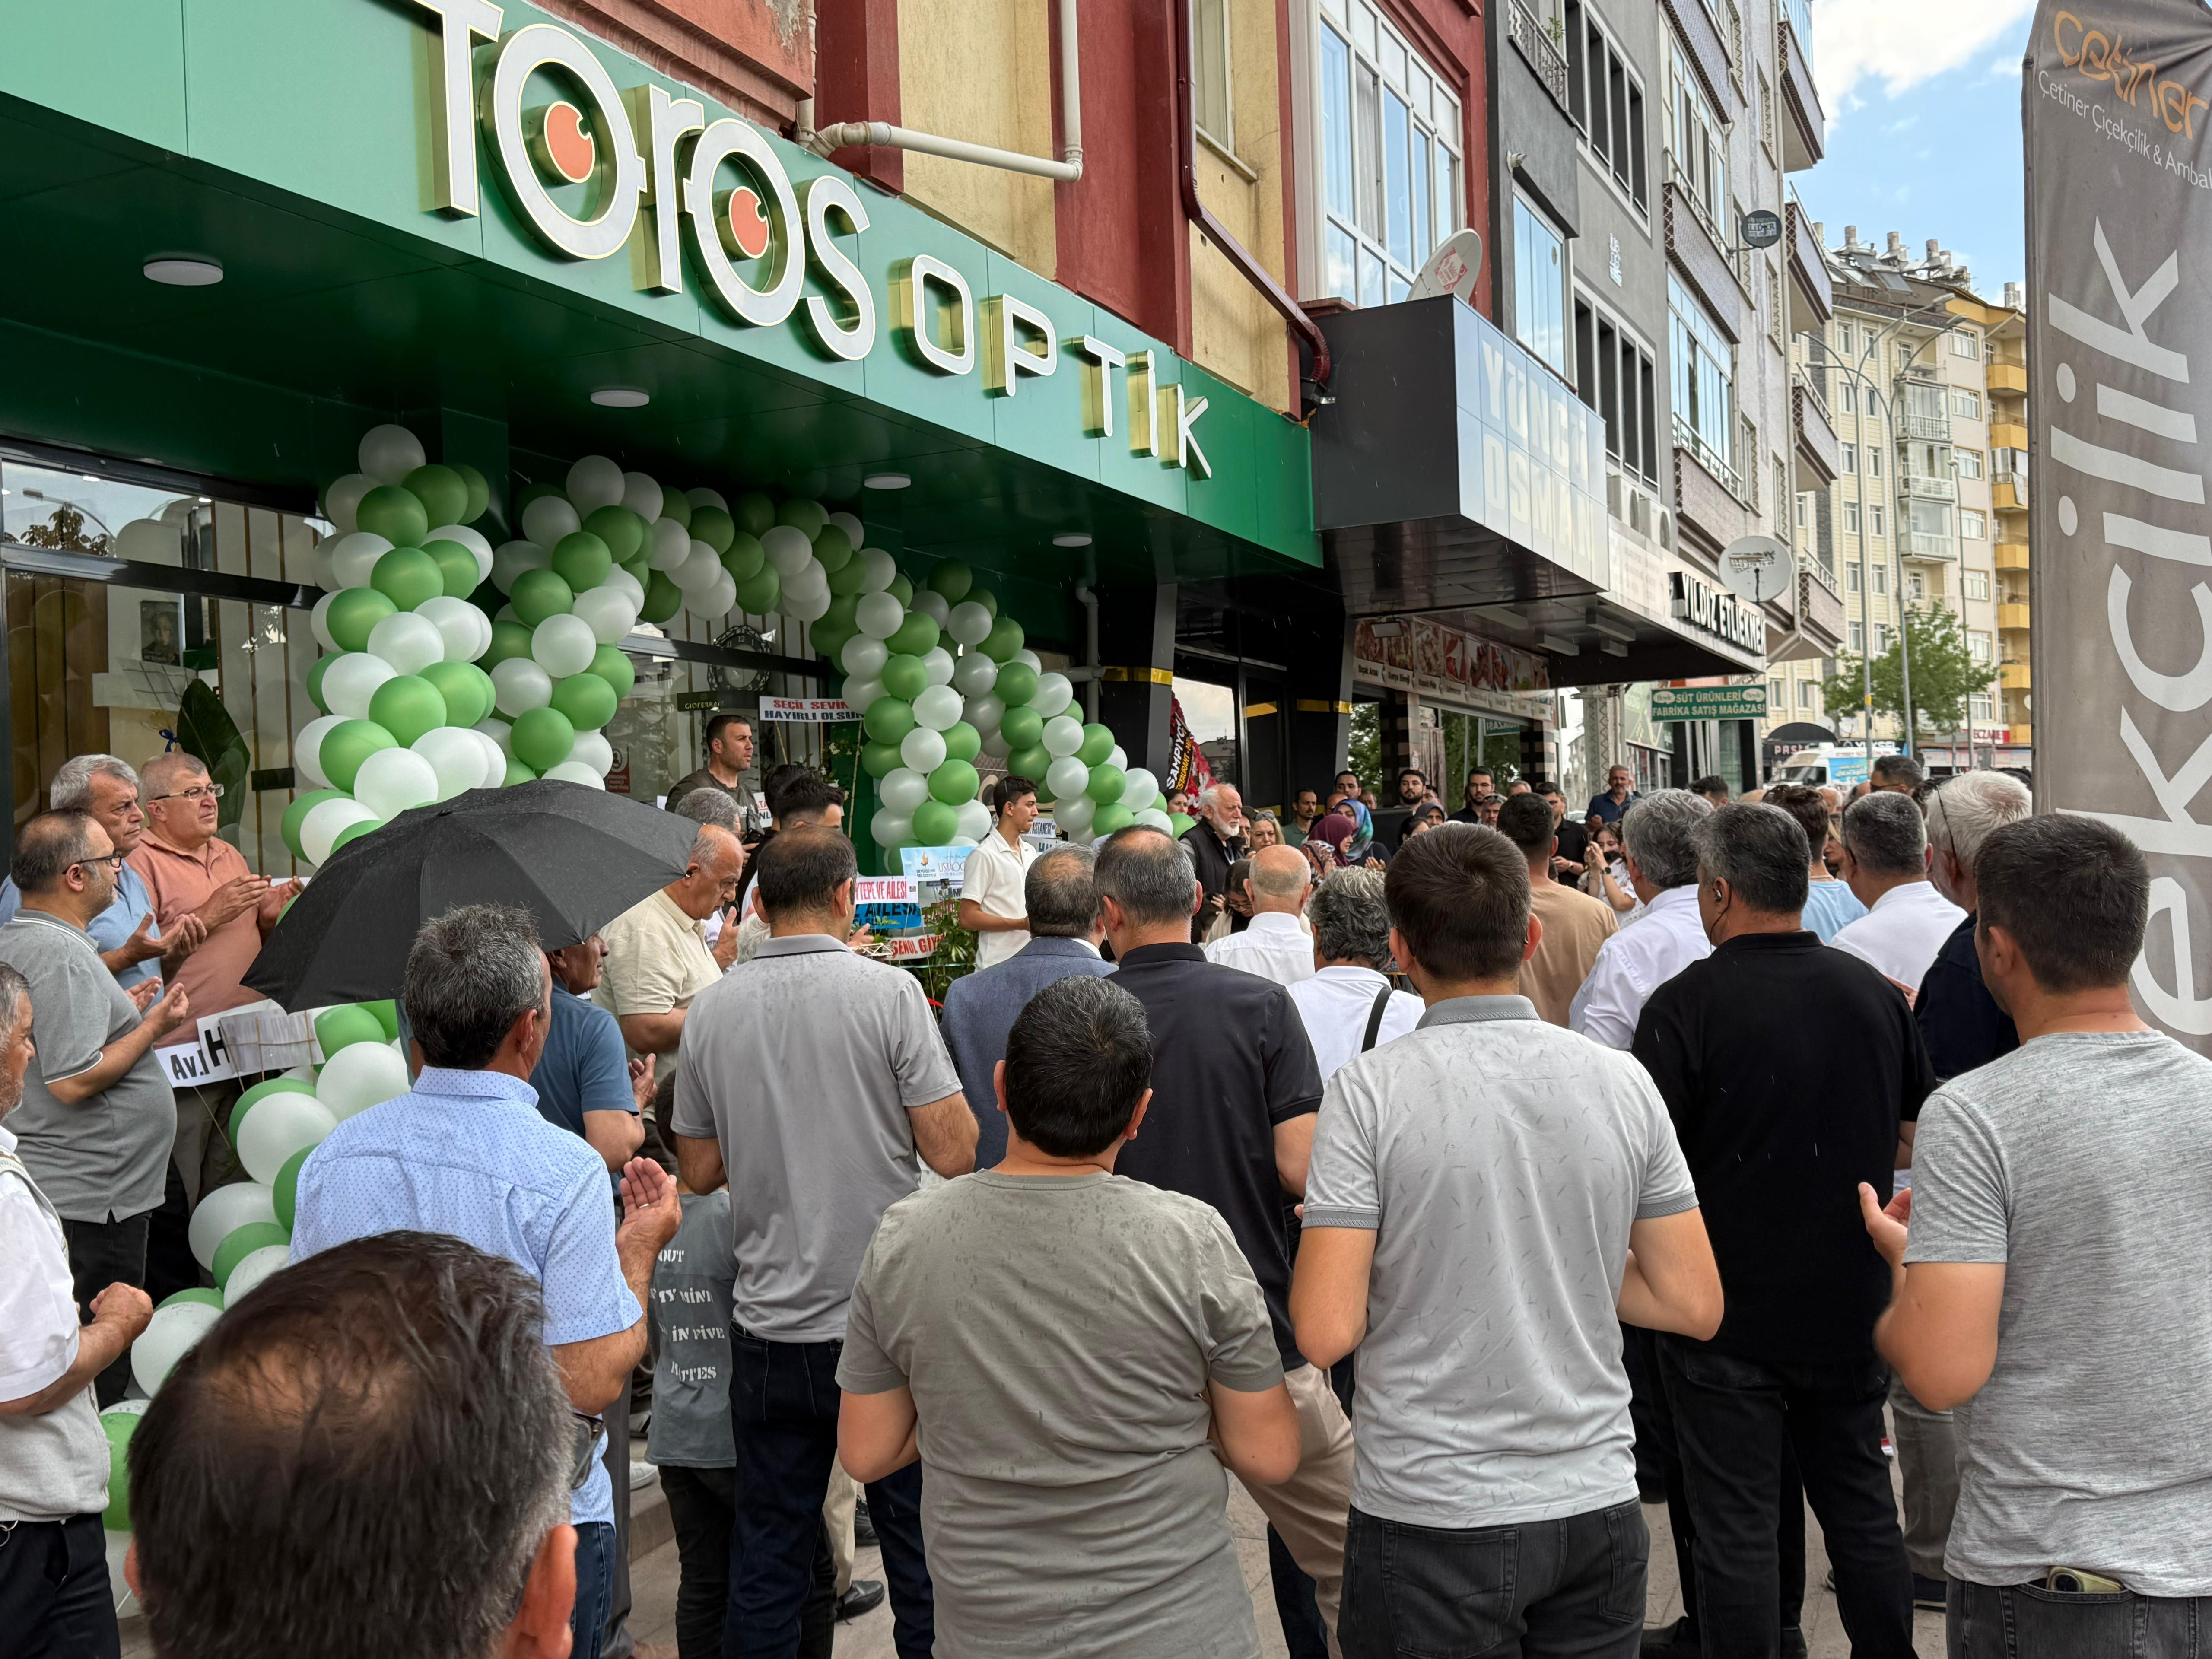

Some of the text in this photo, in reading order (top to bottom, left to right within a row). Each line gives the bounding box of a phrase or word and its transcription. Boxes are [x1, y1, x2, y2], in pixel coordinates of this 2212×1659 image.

[2038, 70, 2090, 119] Çetiner
[2092, 104, 2151, 160] Çiçekçilik
[2153, 145, 2162, 167] &
[1483, 432, 1595, 562] OSMAN
[1681, 571, 1717, 632] YILDIZ
[773, 699, 807, 710] SEÇİL
[1676, 692, 1694, 704] SÜT
[1696, 690, 1741, 703] ÜRÜNLERİ
[764, 710, 817, 720] HAYIRLI
[1652, 702, 1765, 717] FABRİKA SATIŞ MAĞAZASI
[876, 881, 885, 900] VE
[918, 935, 945, 953] GİY
[658, 1249, 684, 1262] OUT
